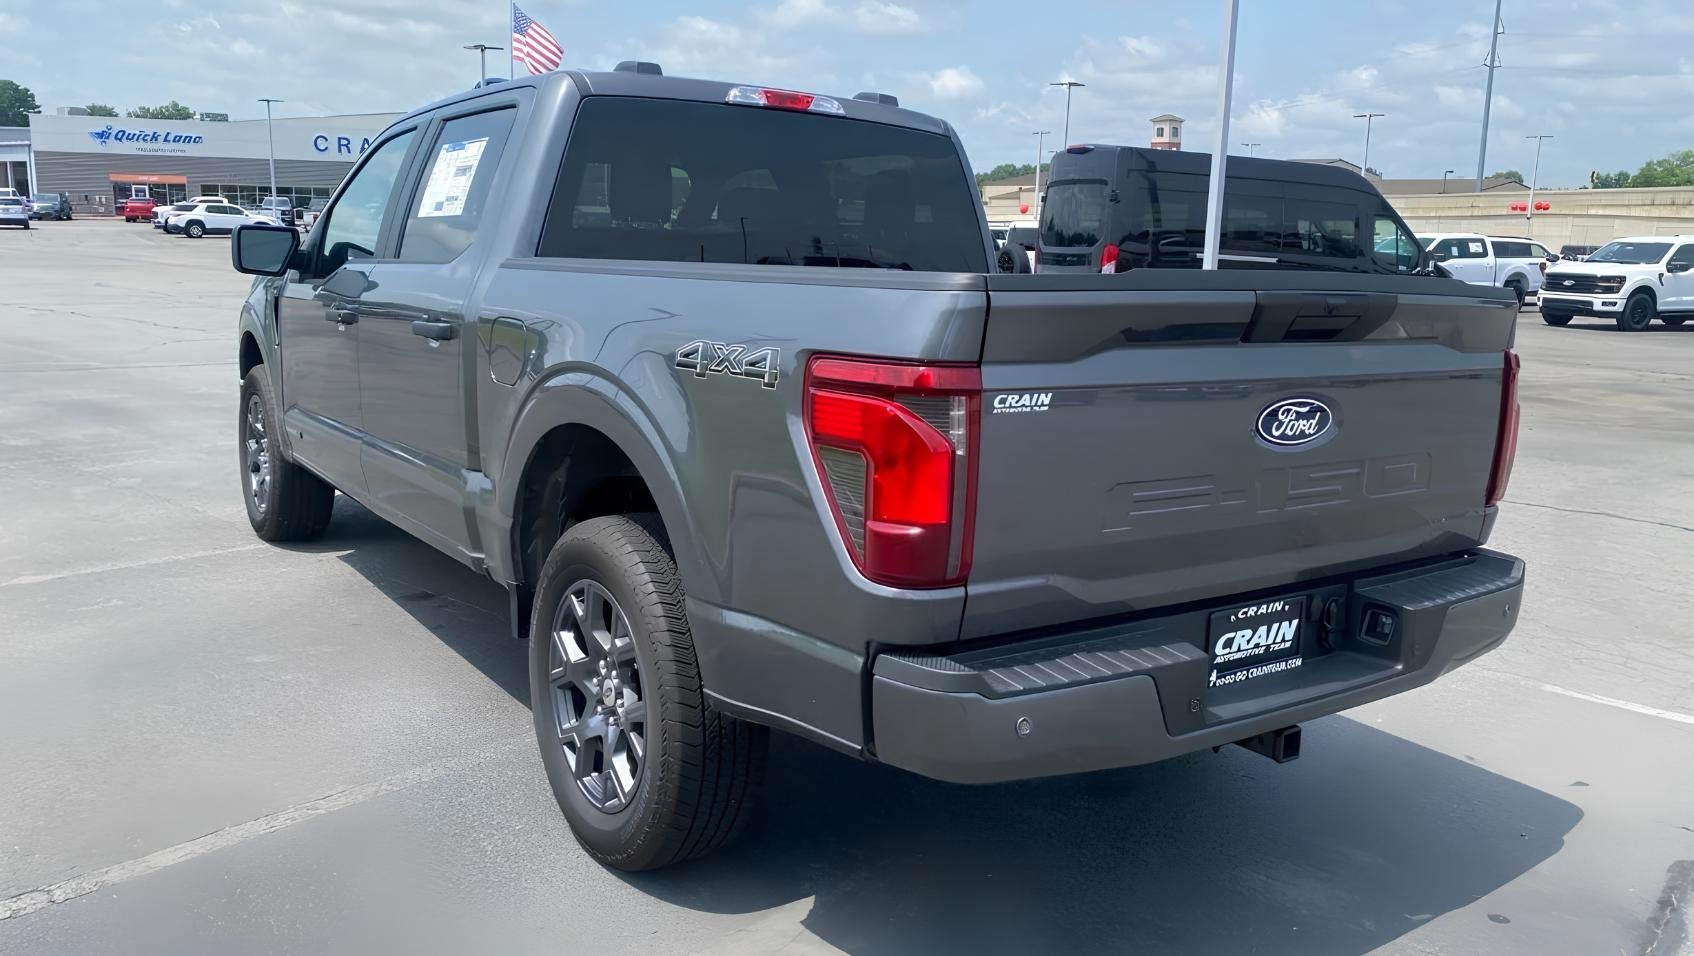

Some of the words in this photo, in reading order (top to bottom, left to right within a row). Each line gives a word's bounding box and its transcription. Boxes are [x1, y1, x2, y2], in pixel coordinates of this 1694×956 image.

[114, 130, 161, 143] Quick
[993, 392, 1053, 408] CRAIN
[1272, 404, 1320, 437] Ford
[1238, 601, 1284, 619] CRAIN
[1214, 618, 1299, 656] CRAIN
